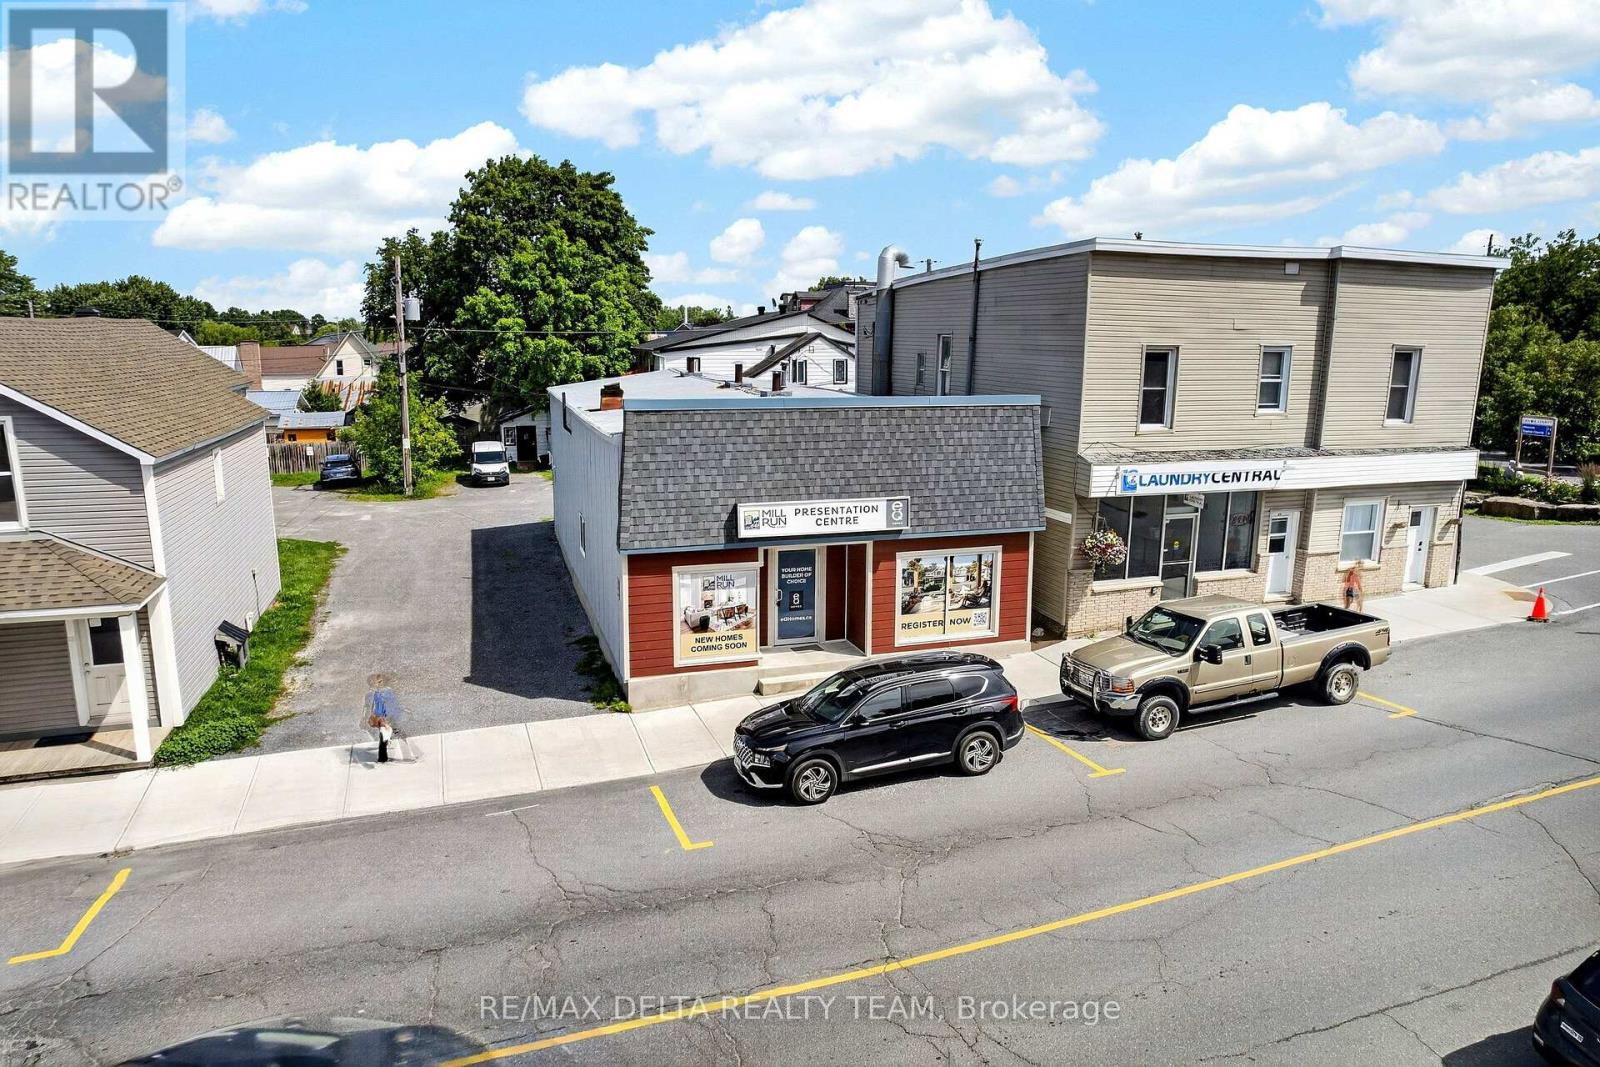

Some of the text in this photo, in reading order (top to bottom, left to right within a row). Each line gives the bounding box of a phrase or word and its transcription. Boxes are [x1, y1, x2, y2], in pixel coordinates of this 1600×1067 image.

[761, 509, 787, 518] MILL
[794, 504, 879, 516] PRESENTATION
[761, 517, 787, 528] RUN
[815, 516, 860, 527] CENTRE
[716, 574, 734, 582] MILL
[716, 581, 735, 589] RUN
[901, 616, 972, 630] REGISTER NOW
[694, 633, 744, 644] NEW HOMES
[690, 641, 748, 653] COMING SOON
